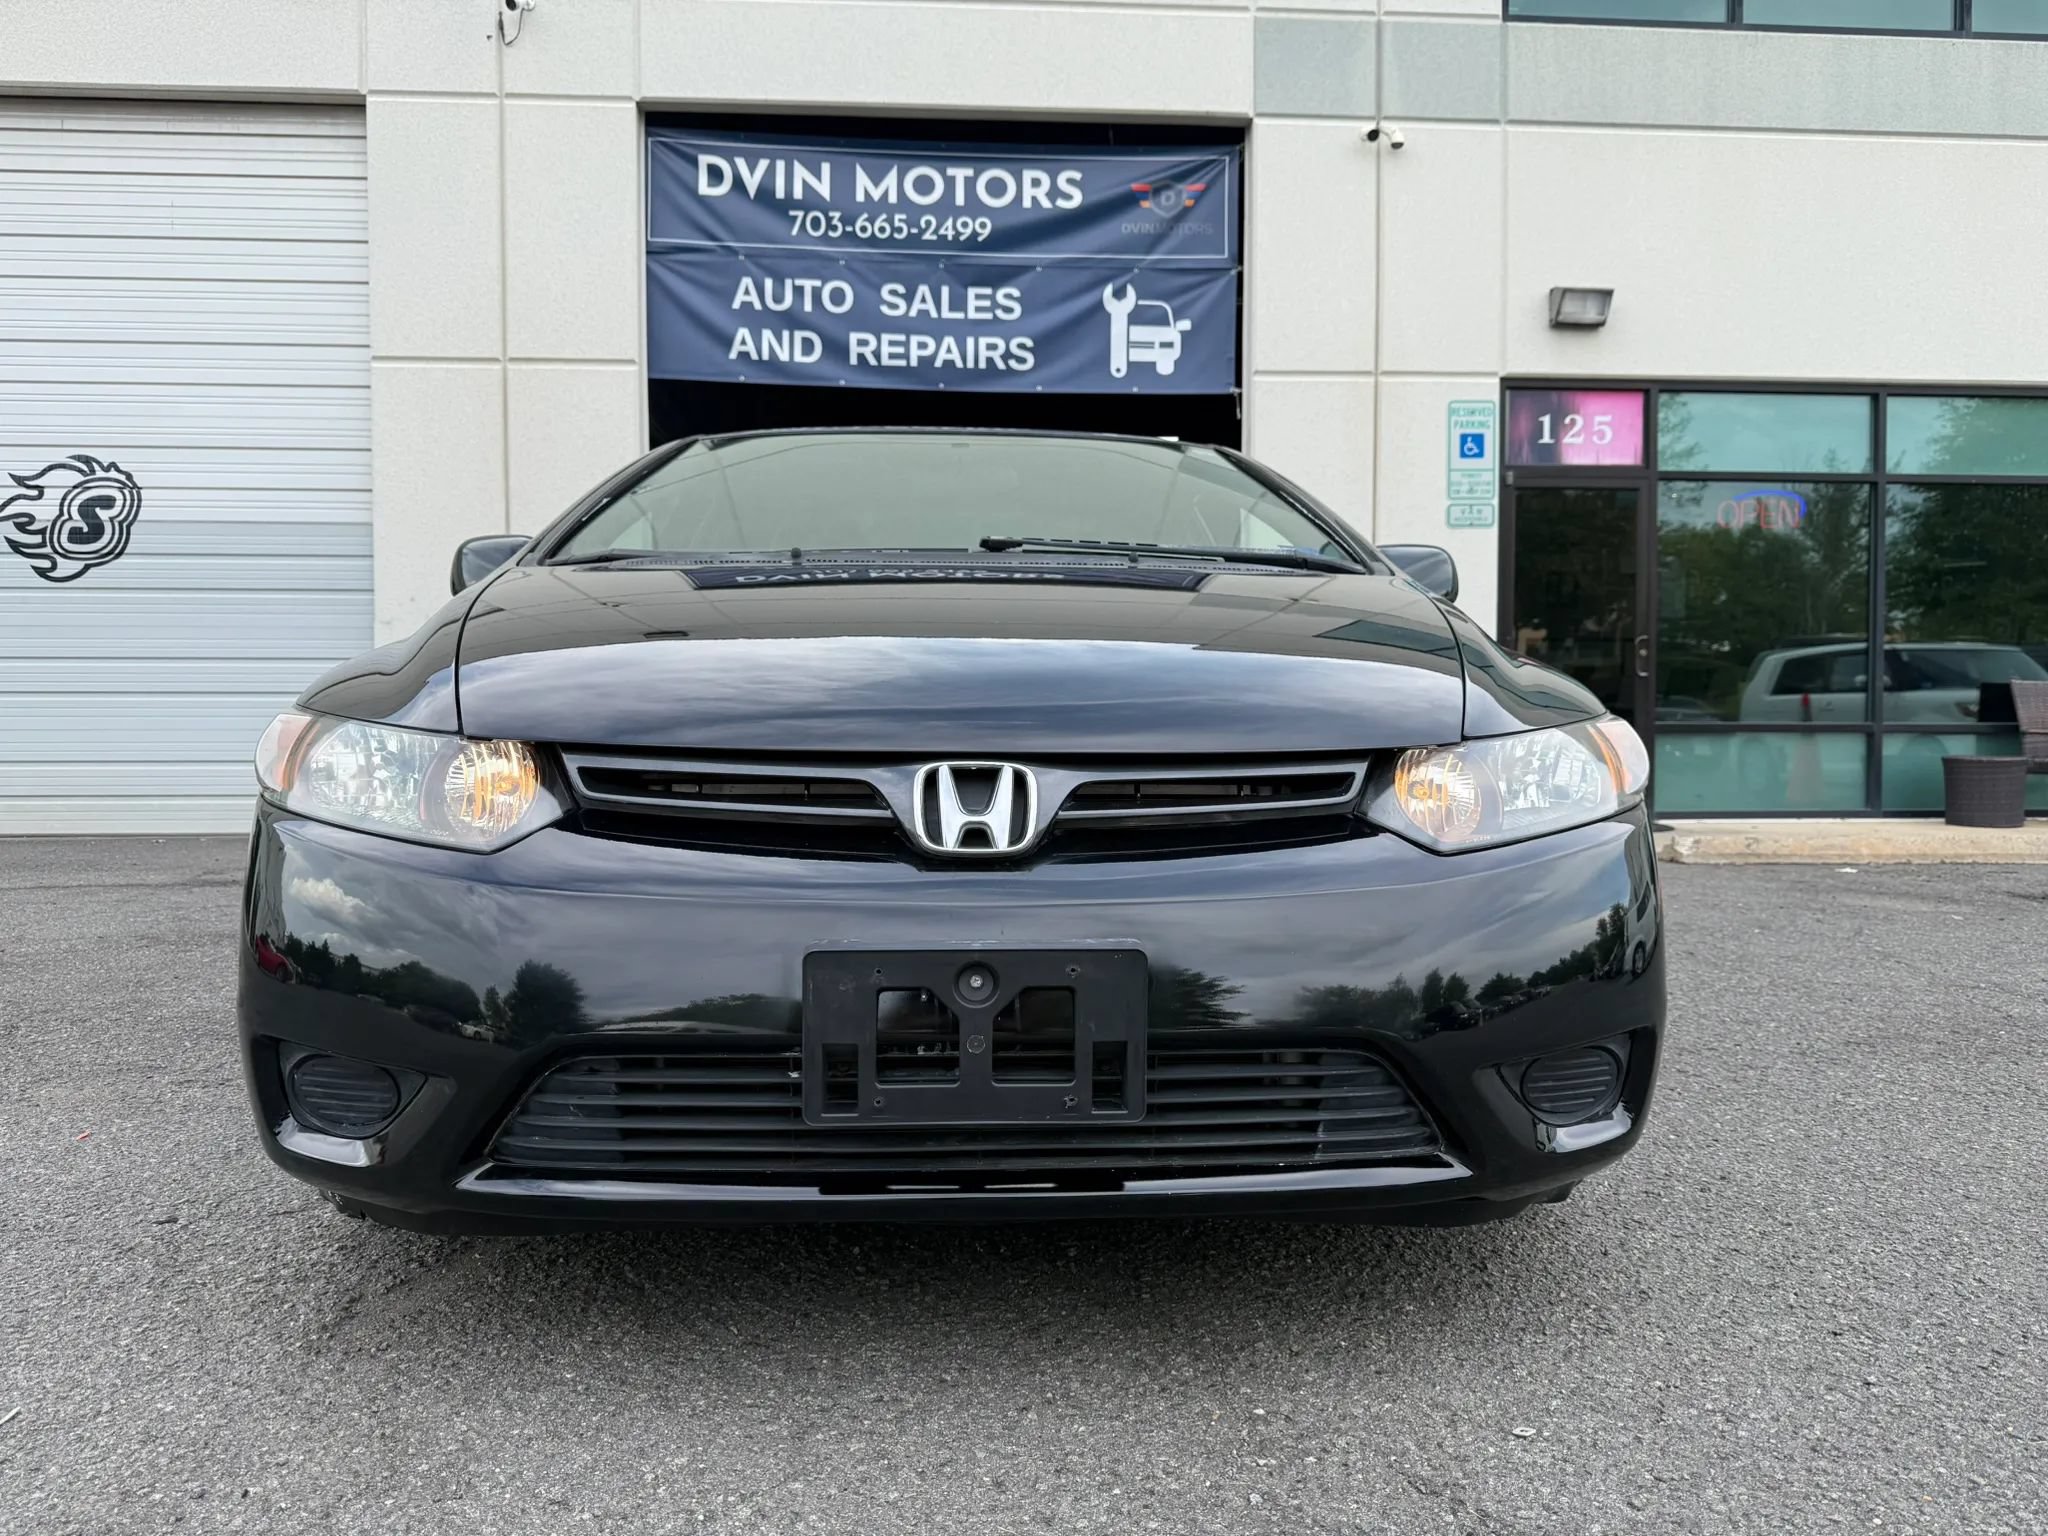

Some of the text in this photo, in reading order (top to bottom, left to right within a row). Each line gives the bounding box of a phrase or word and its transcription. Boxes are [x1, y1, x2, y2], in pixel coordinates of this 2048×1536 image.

[697, 153, 1084, 210] DVIN MOTORS
[788, 210, 993, 242] 703-665-2499
[1121, 223, 1214, 235] DVINMTORS
[731, 276, 1023, 321] AUTO SALES
[728, 326, 1036, 372] AND REPAIRS
[1537, 413, 1613, 445] 125
[1716, 500, 1802, 530] OPEN
